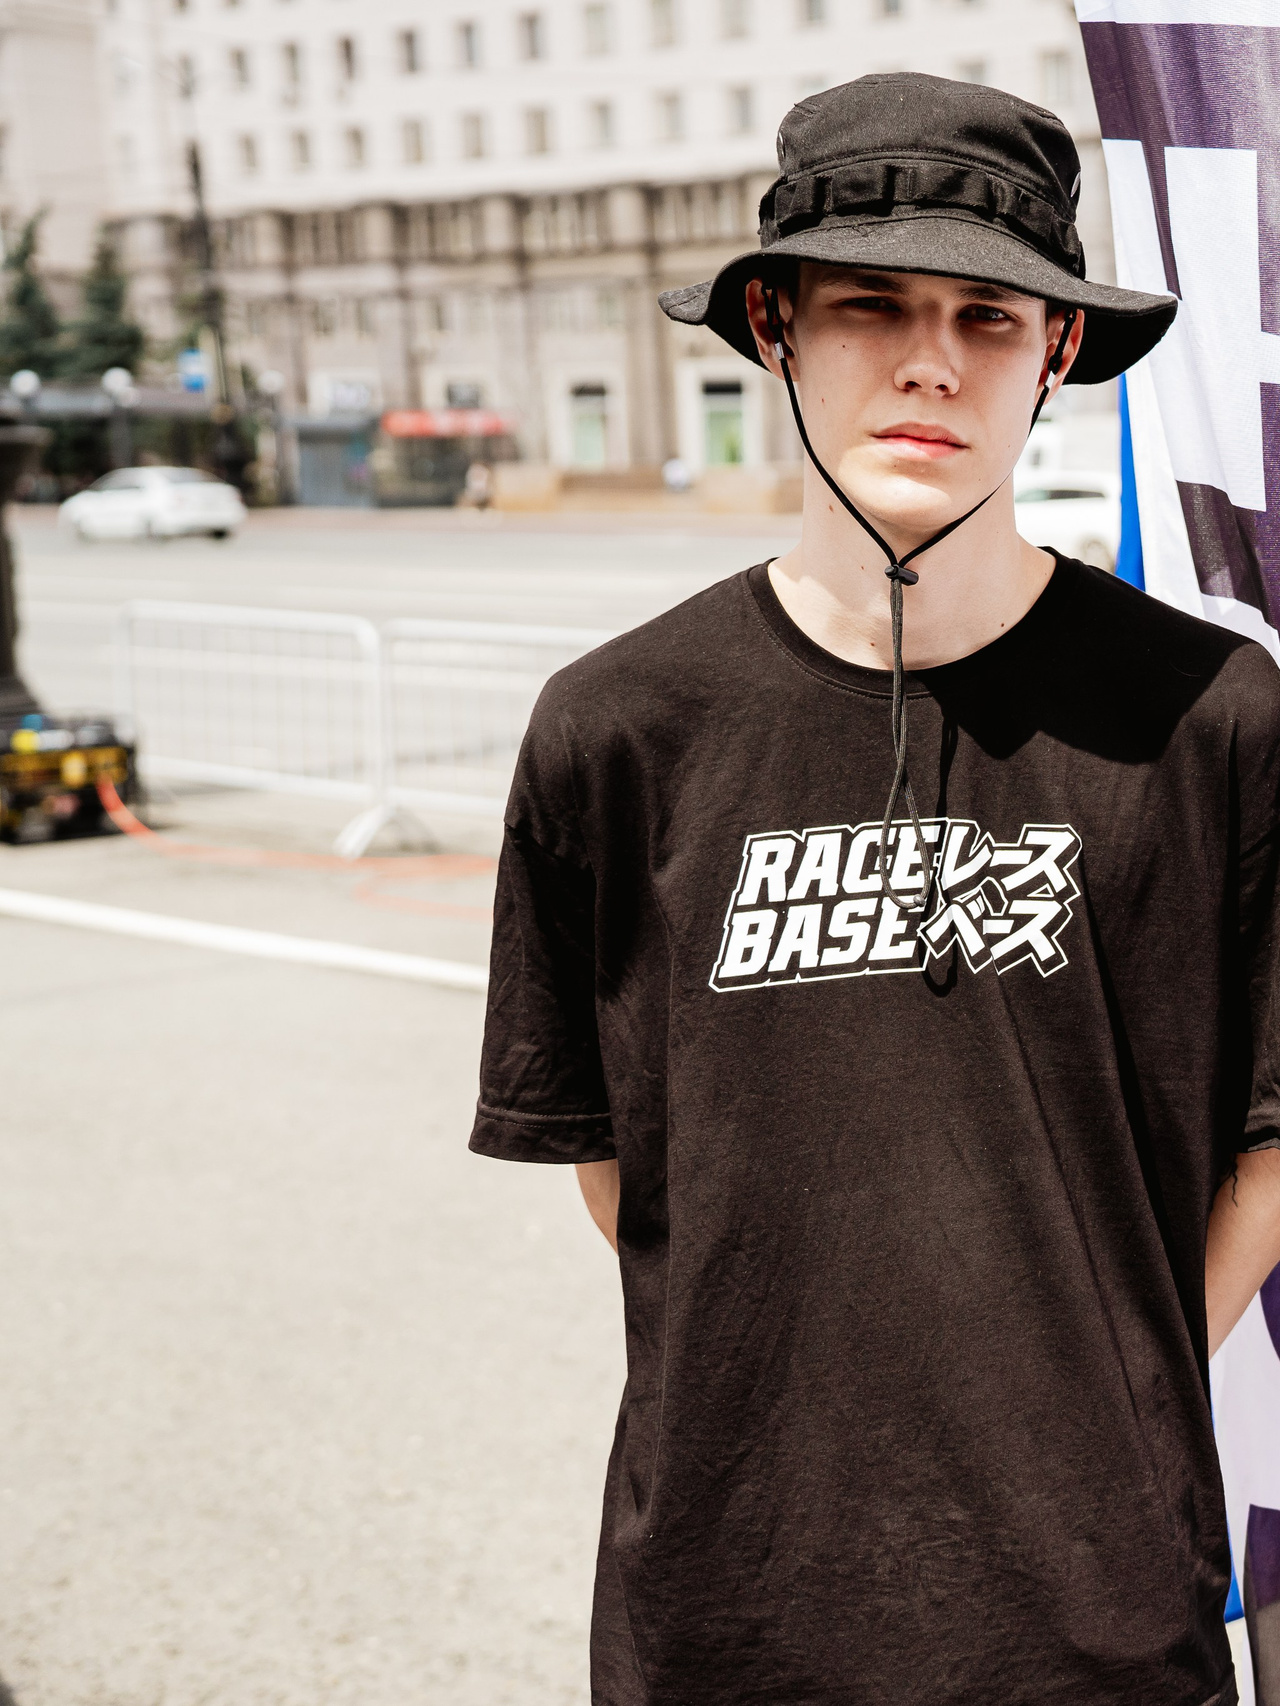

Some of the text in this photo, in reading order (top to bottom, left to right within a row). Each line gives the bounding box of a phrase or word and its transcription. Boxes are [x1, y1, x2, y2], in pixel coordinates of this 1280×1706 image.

[736, 825, 942, 906] RACE
[942, 825, 1076, 894] レース
[718, 895, 928, 979] BASE
[928, 895, 1063, 962] ベース
